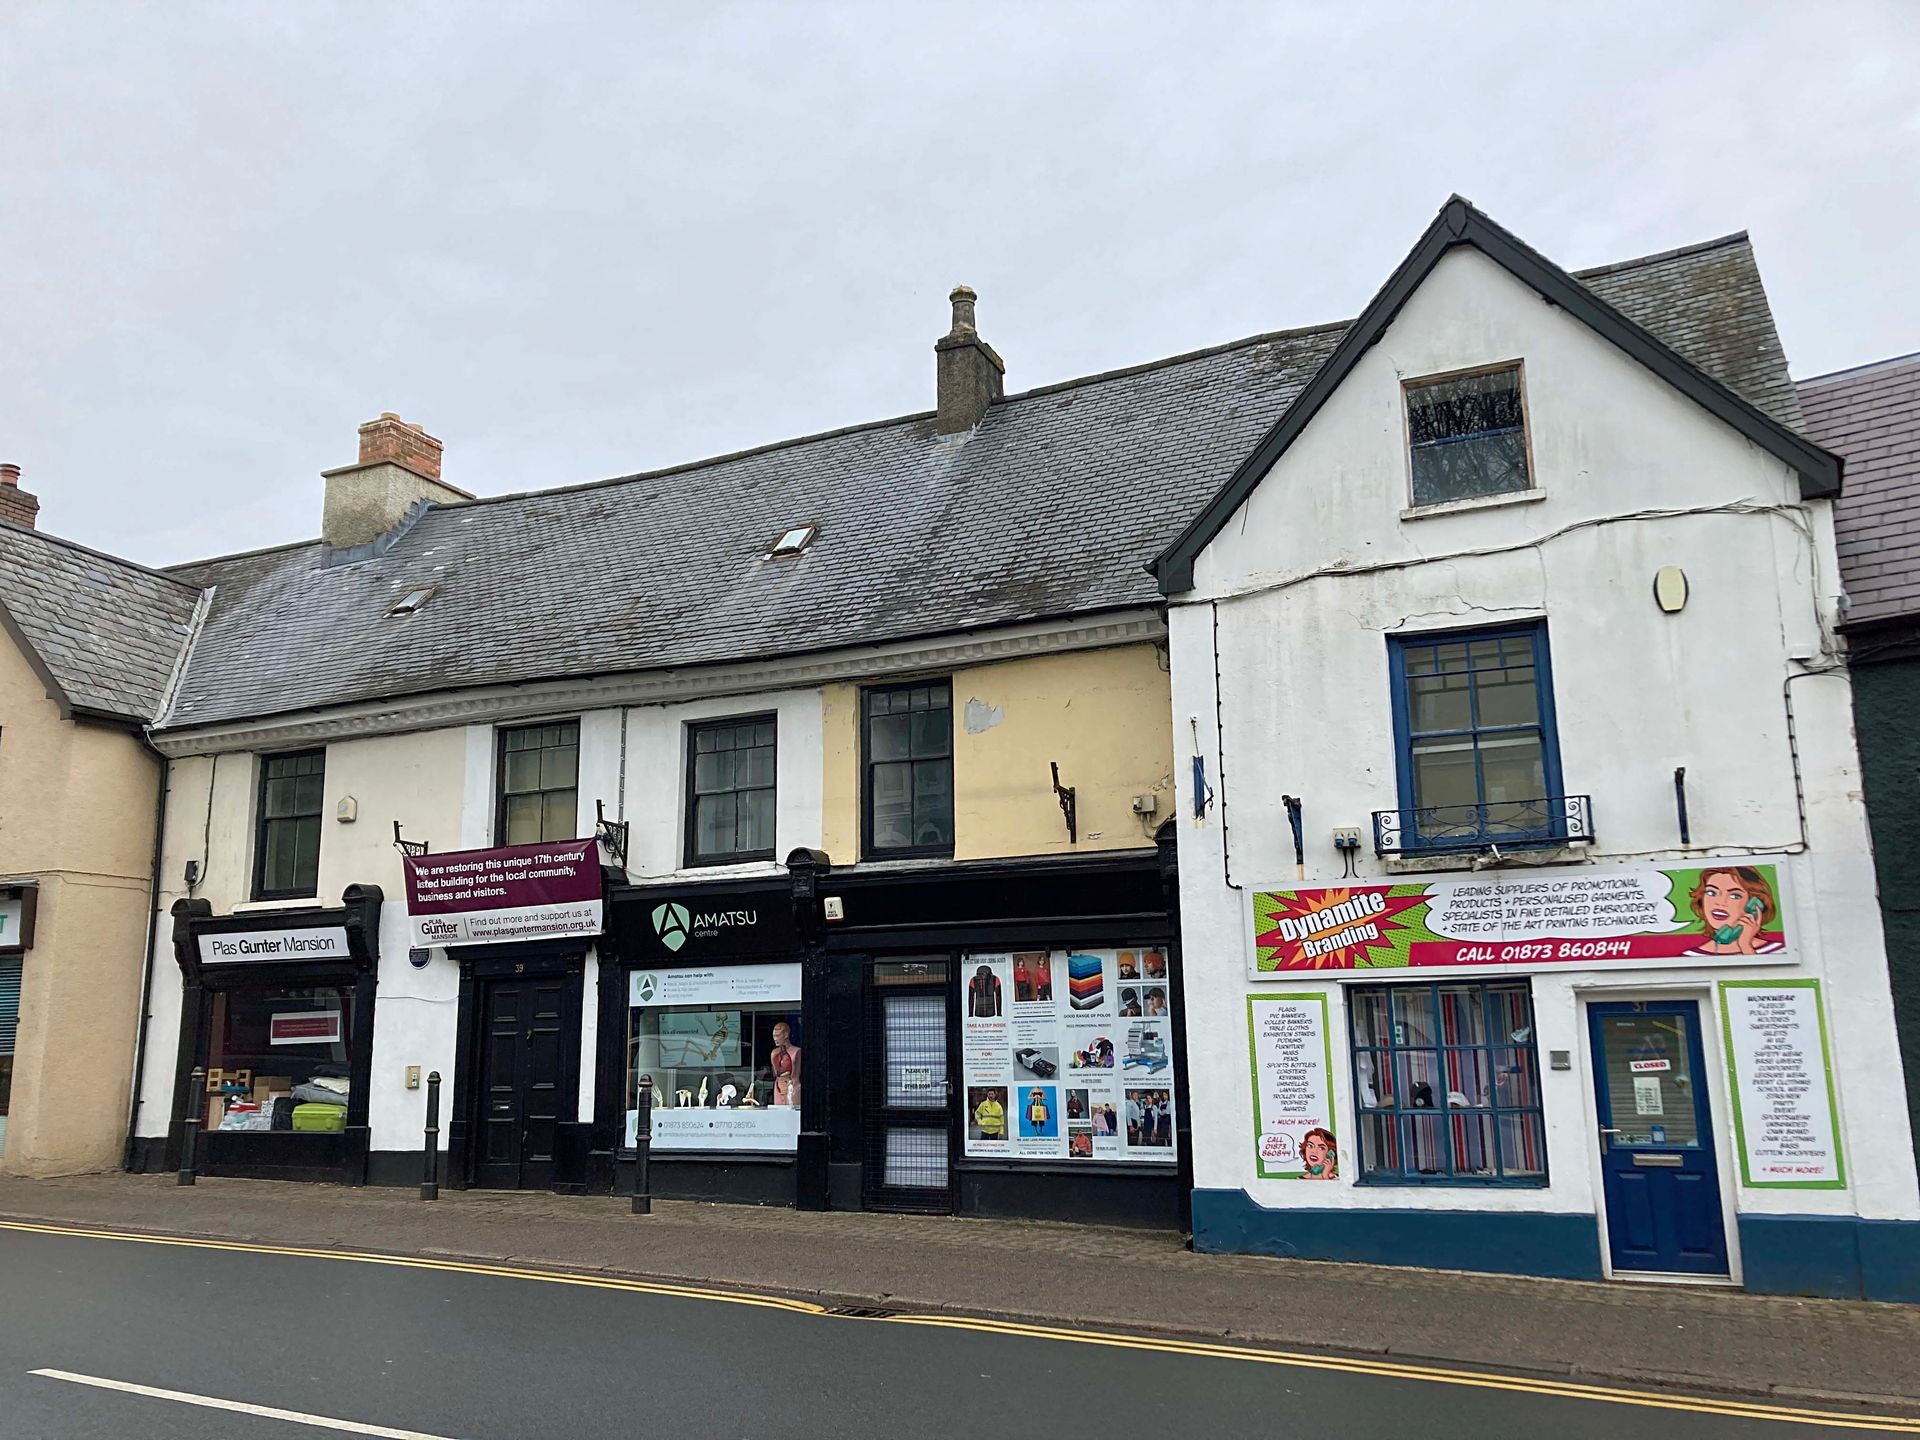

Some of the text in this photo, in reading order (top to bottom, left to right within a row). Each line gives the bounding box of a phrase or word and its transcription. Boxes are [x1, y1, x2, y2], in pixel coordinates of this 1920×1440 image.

[416, 852, 585, 876] We are restoring this unique 17th century
[417, 866, 576, 889] listed building for the local community,
[418, 886, 507, 902] business and visitors.
[1453, 878, 1640, 898] LEADING SUPPLIERS OF PROMOTIONAL
[1450, 897, 1502, 909] PRODUCTS
[1512, 893, 1588, 906] PERSONALISED
[1591, 890, 1646, 902] GARMENTS.
[470, 908, 592, 926] Find out more and support us at
[694, 910, 757, 928] AMATSU
[1278, 891, 1386, 942] Dynamite
[1441, 901, 1659, 921] SPECIALISTS IN FINE DETAILED EMBROIDERY
[421, 922, 458, 935] Gunter
[472, 919, 596, 937] www.plasguntermansion.org.uk
[695, 929, 718, 937] centre
[1451, 923, 1480, 933] STATE
[1482, 922, 1498, 932] OF
[1502, 921, 1521, 931] THE
[1523, 919, 1542, 930] ART
[1545, 917, 1589, 929] PRINTING
[1592, 914, 1659, 927] TECHNIQUES.
[212, 936, 335, 956] Plas Gunter Mansion
[432, 933, 458, 941] MANSION
[1302, 922, 1379, 958] Branding
[1456, 940, 1631, 961] CALL 01873 860844
[1634, 1061, 1666, 1069] CLOSED
